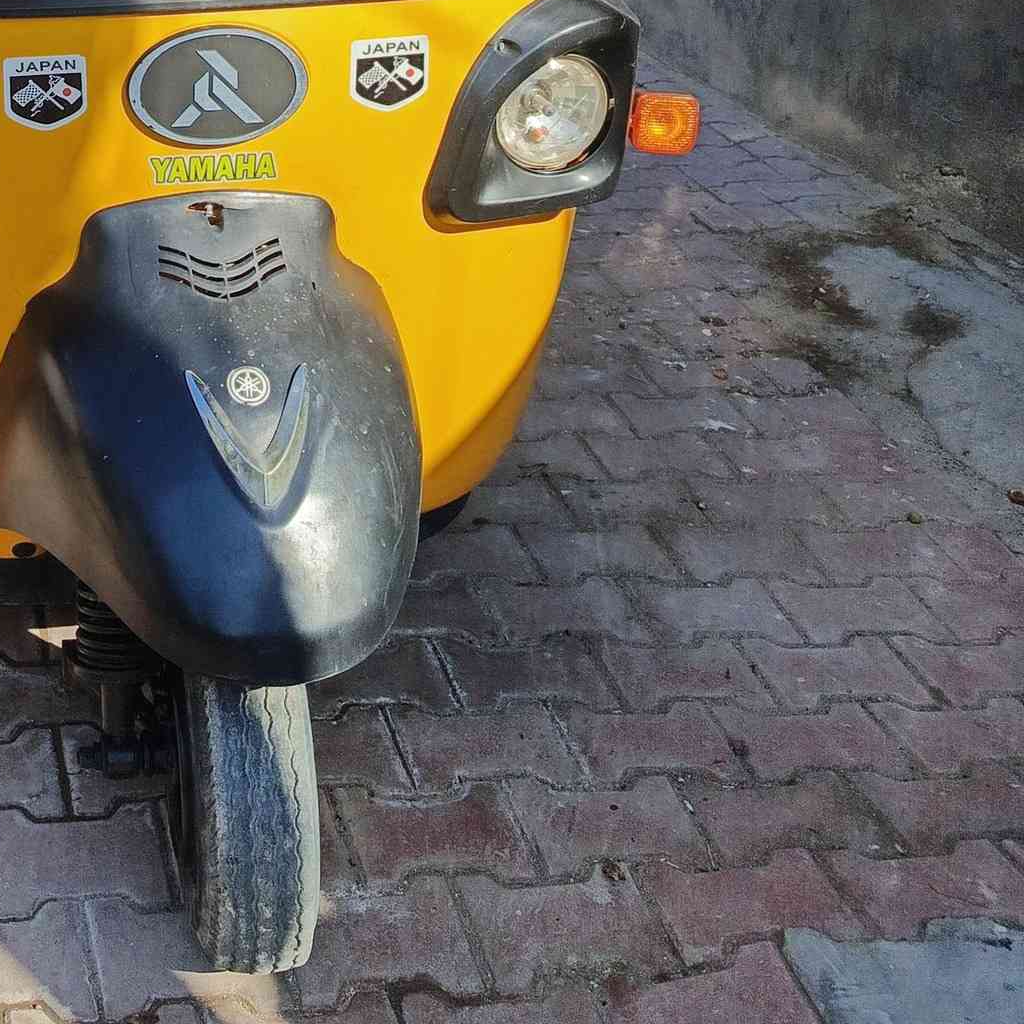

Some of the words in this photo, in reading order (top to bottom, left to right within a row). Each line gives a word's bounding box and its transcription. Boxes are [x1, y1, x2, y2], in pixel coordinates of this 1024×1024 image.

[362, 39, 422, 56] JAPAN
[15, 58, 77, 74] JAPAN
[151, 151, 277, 184] YAMAHA
